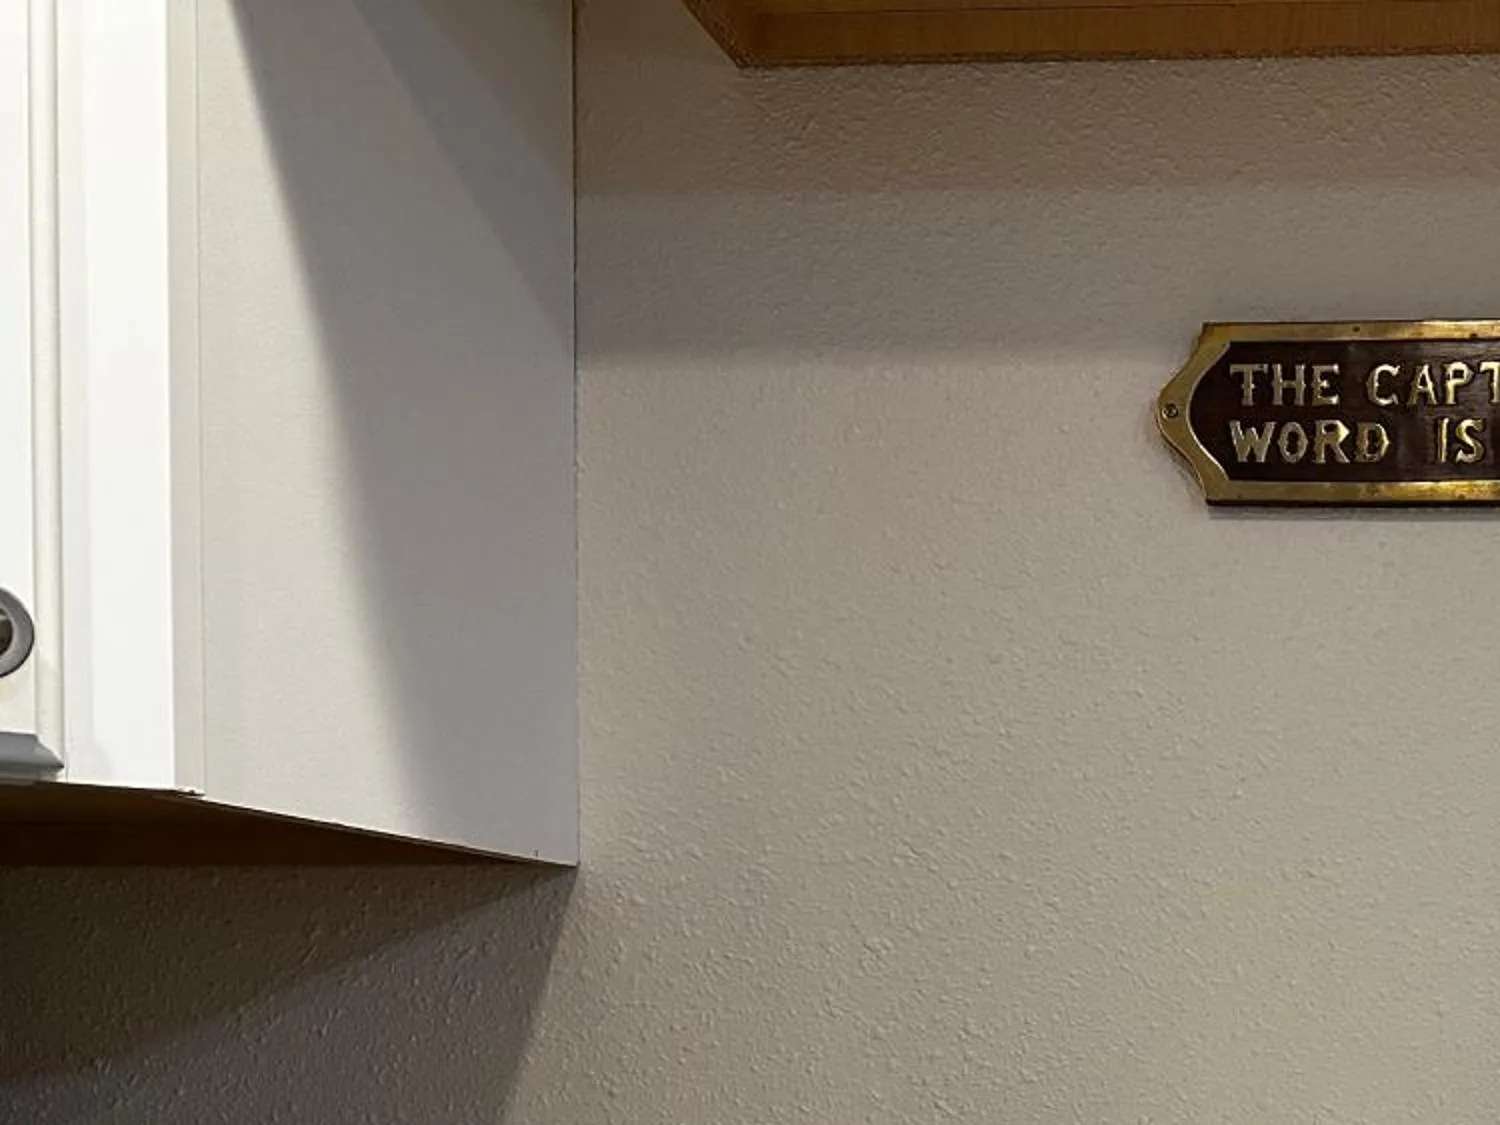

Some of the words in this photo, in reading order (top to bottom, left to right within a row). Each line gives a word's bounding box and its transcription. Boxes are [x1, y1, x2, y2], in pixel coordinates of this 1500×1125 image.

[1230, 363, 1340, 405] THE
[1229, 419, 1390, 464] WORD
[1437, 418, 1486, 464] IS
